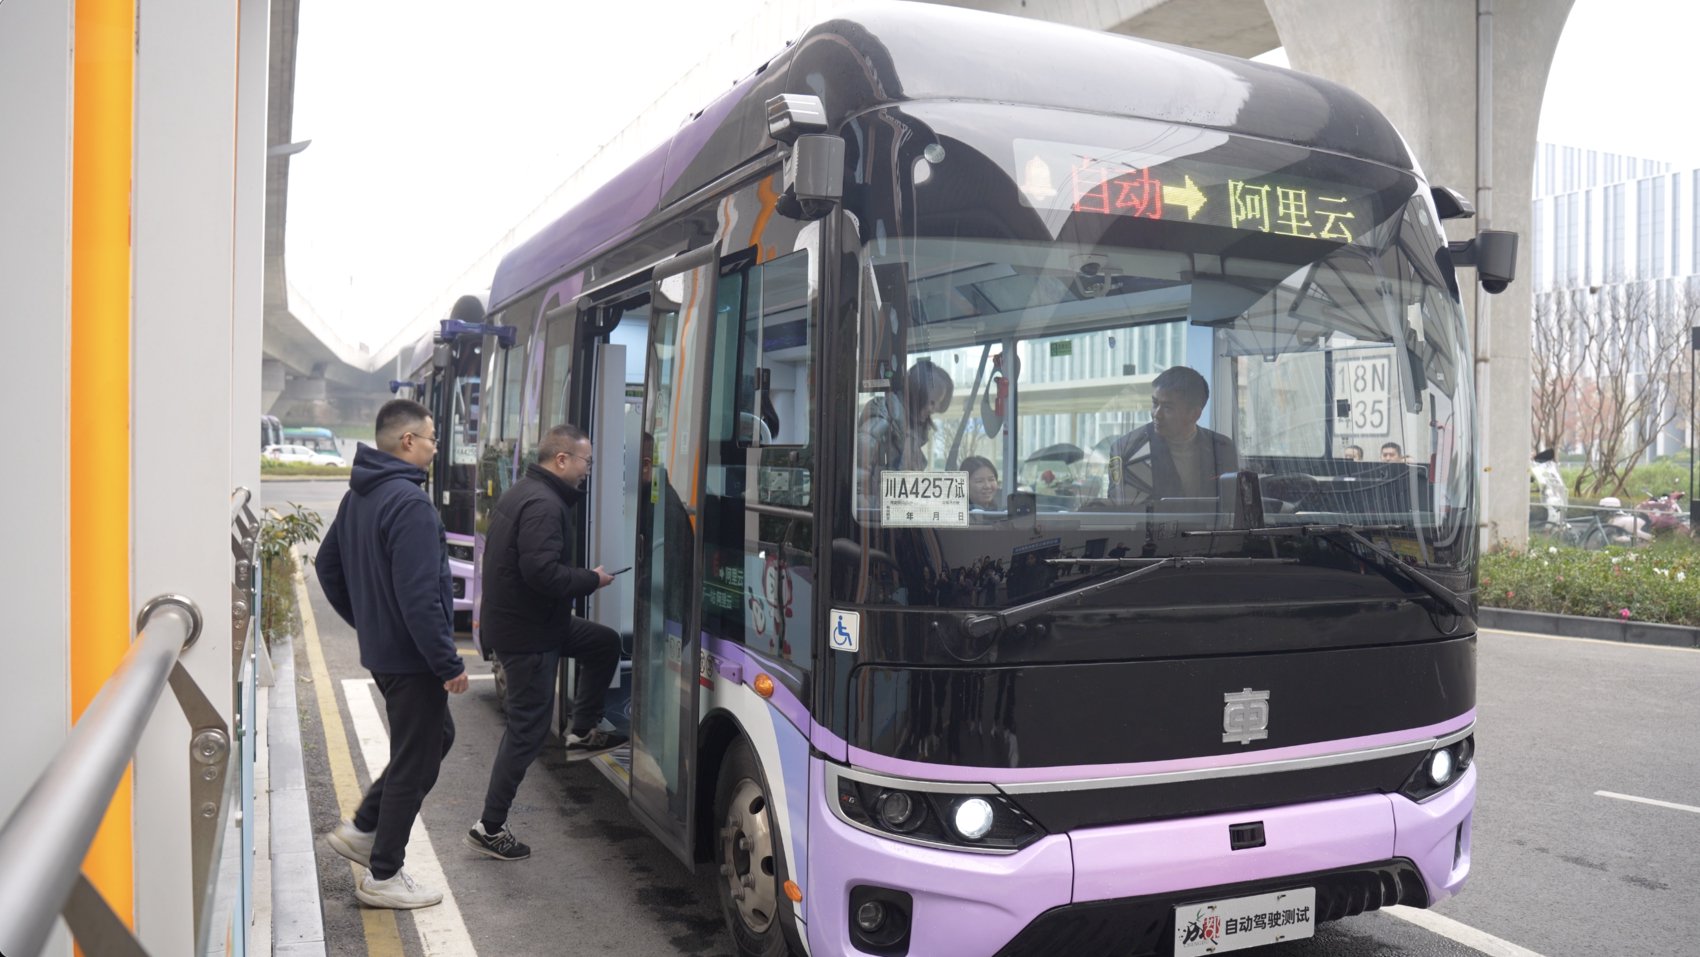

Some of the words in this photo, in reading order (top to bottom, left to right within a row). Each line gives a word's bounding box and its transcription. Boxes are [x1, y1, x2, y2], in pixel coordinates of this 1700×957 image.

[1071, 156, 1162, 220] 自动
[1228, 179, 1355, 243] 阿里云
[1338, 363, 1385, 394] 18N
[884, 477, 965, 499] 川A4257试
[932, 511, 940, 521] 月
[958, 511, 964, 521] 日
[1225, 906, 1310, 936] 自动驾驶测试
